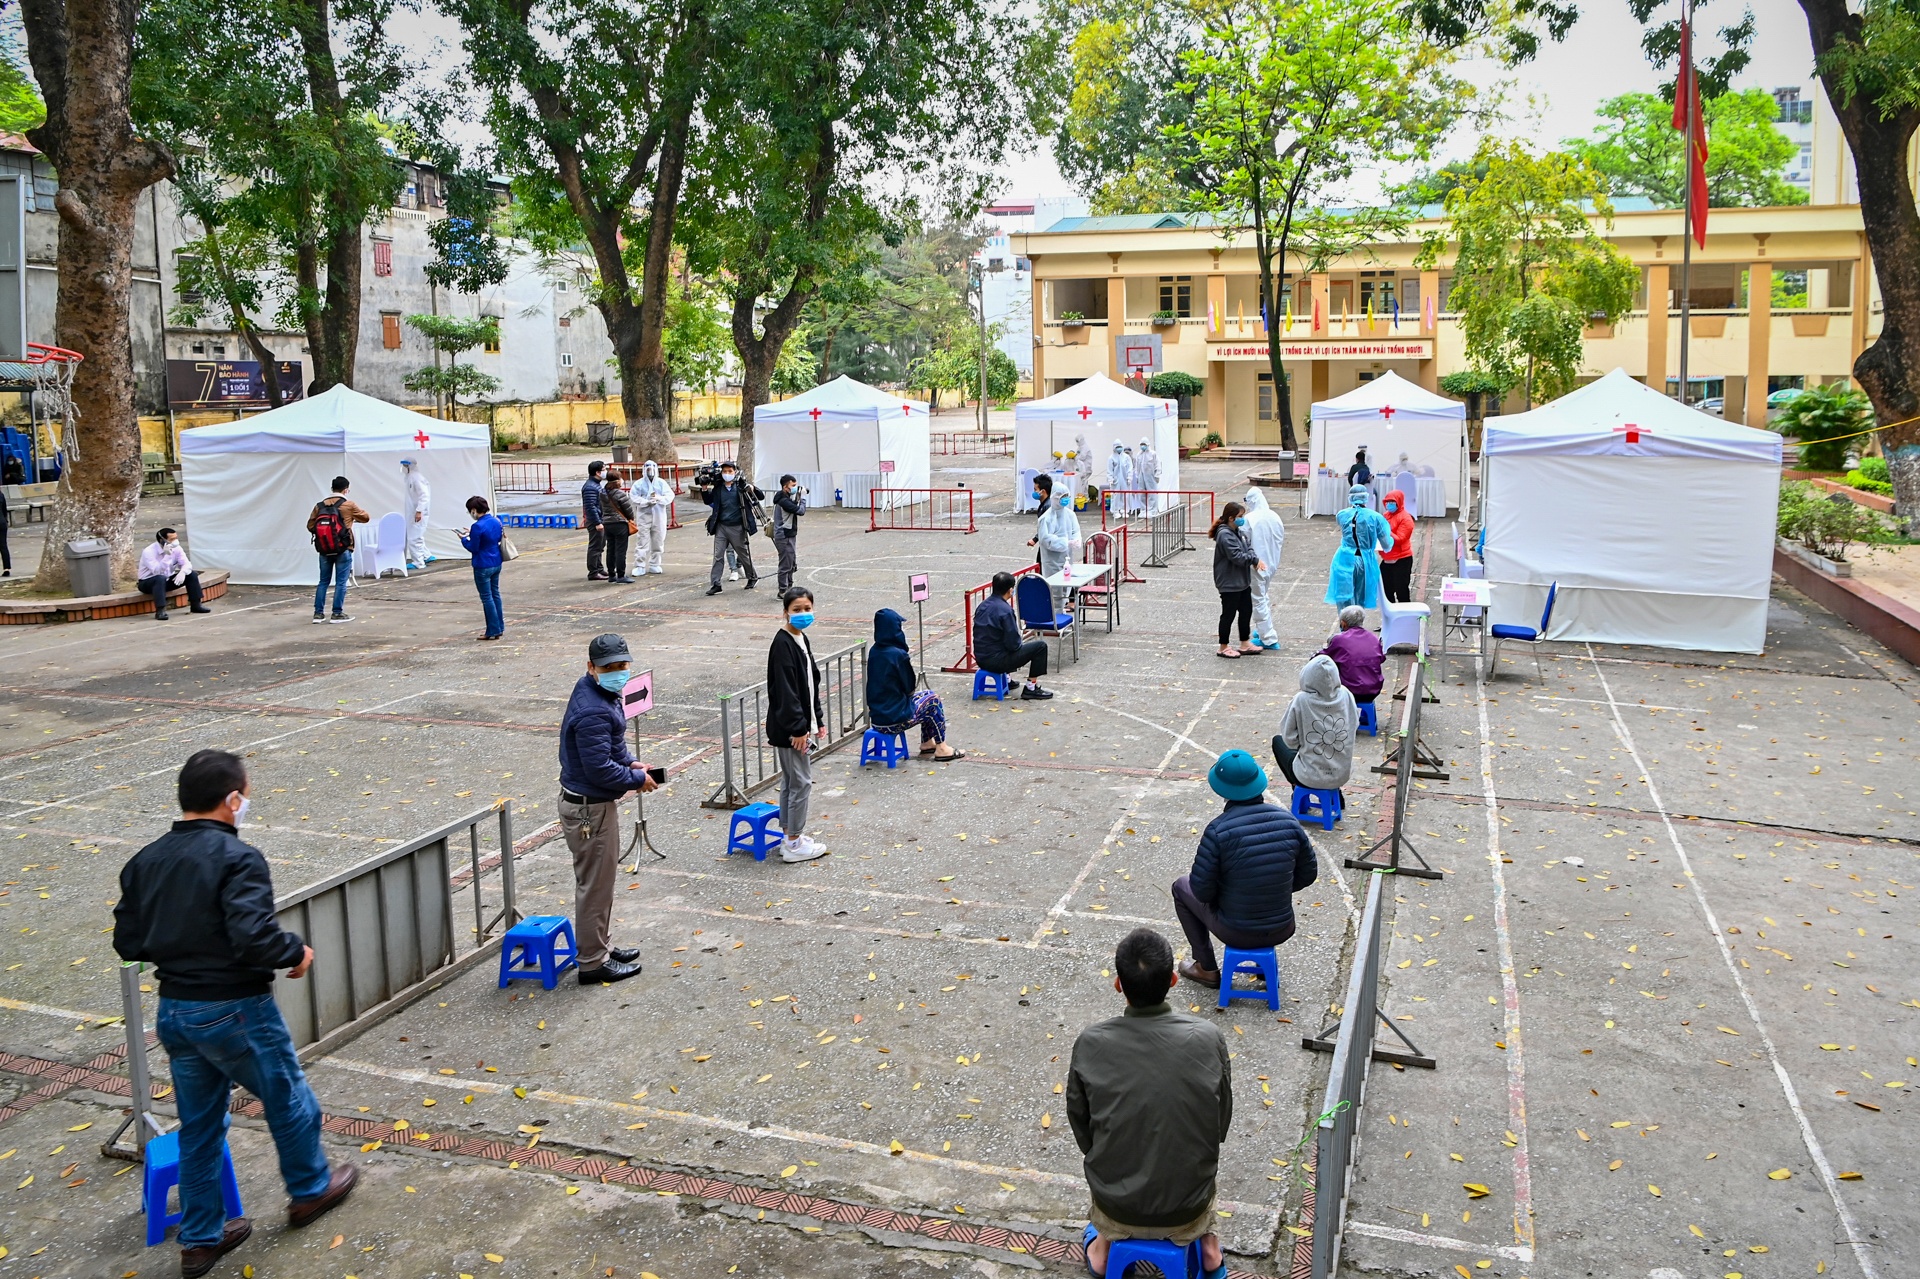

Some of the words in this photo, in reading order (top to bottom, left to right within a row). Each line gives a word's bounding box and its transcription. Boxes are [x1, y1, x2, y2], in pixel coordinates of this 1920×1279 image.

[1233, 346, 1241, 355] ÍCH
[1315, 346, 1320, 354] VÌ
[1322, 346, 1330, 355] LỢI
[1332, 345, 1340, 355] ÍCH
[1342, 345, 1357, 354] TRĂM
[1359, 345, 1371, 354] NĂM
[1373, 344, 1386, 354] PHẢI
[195, 363, 217, 402] 7
